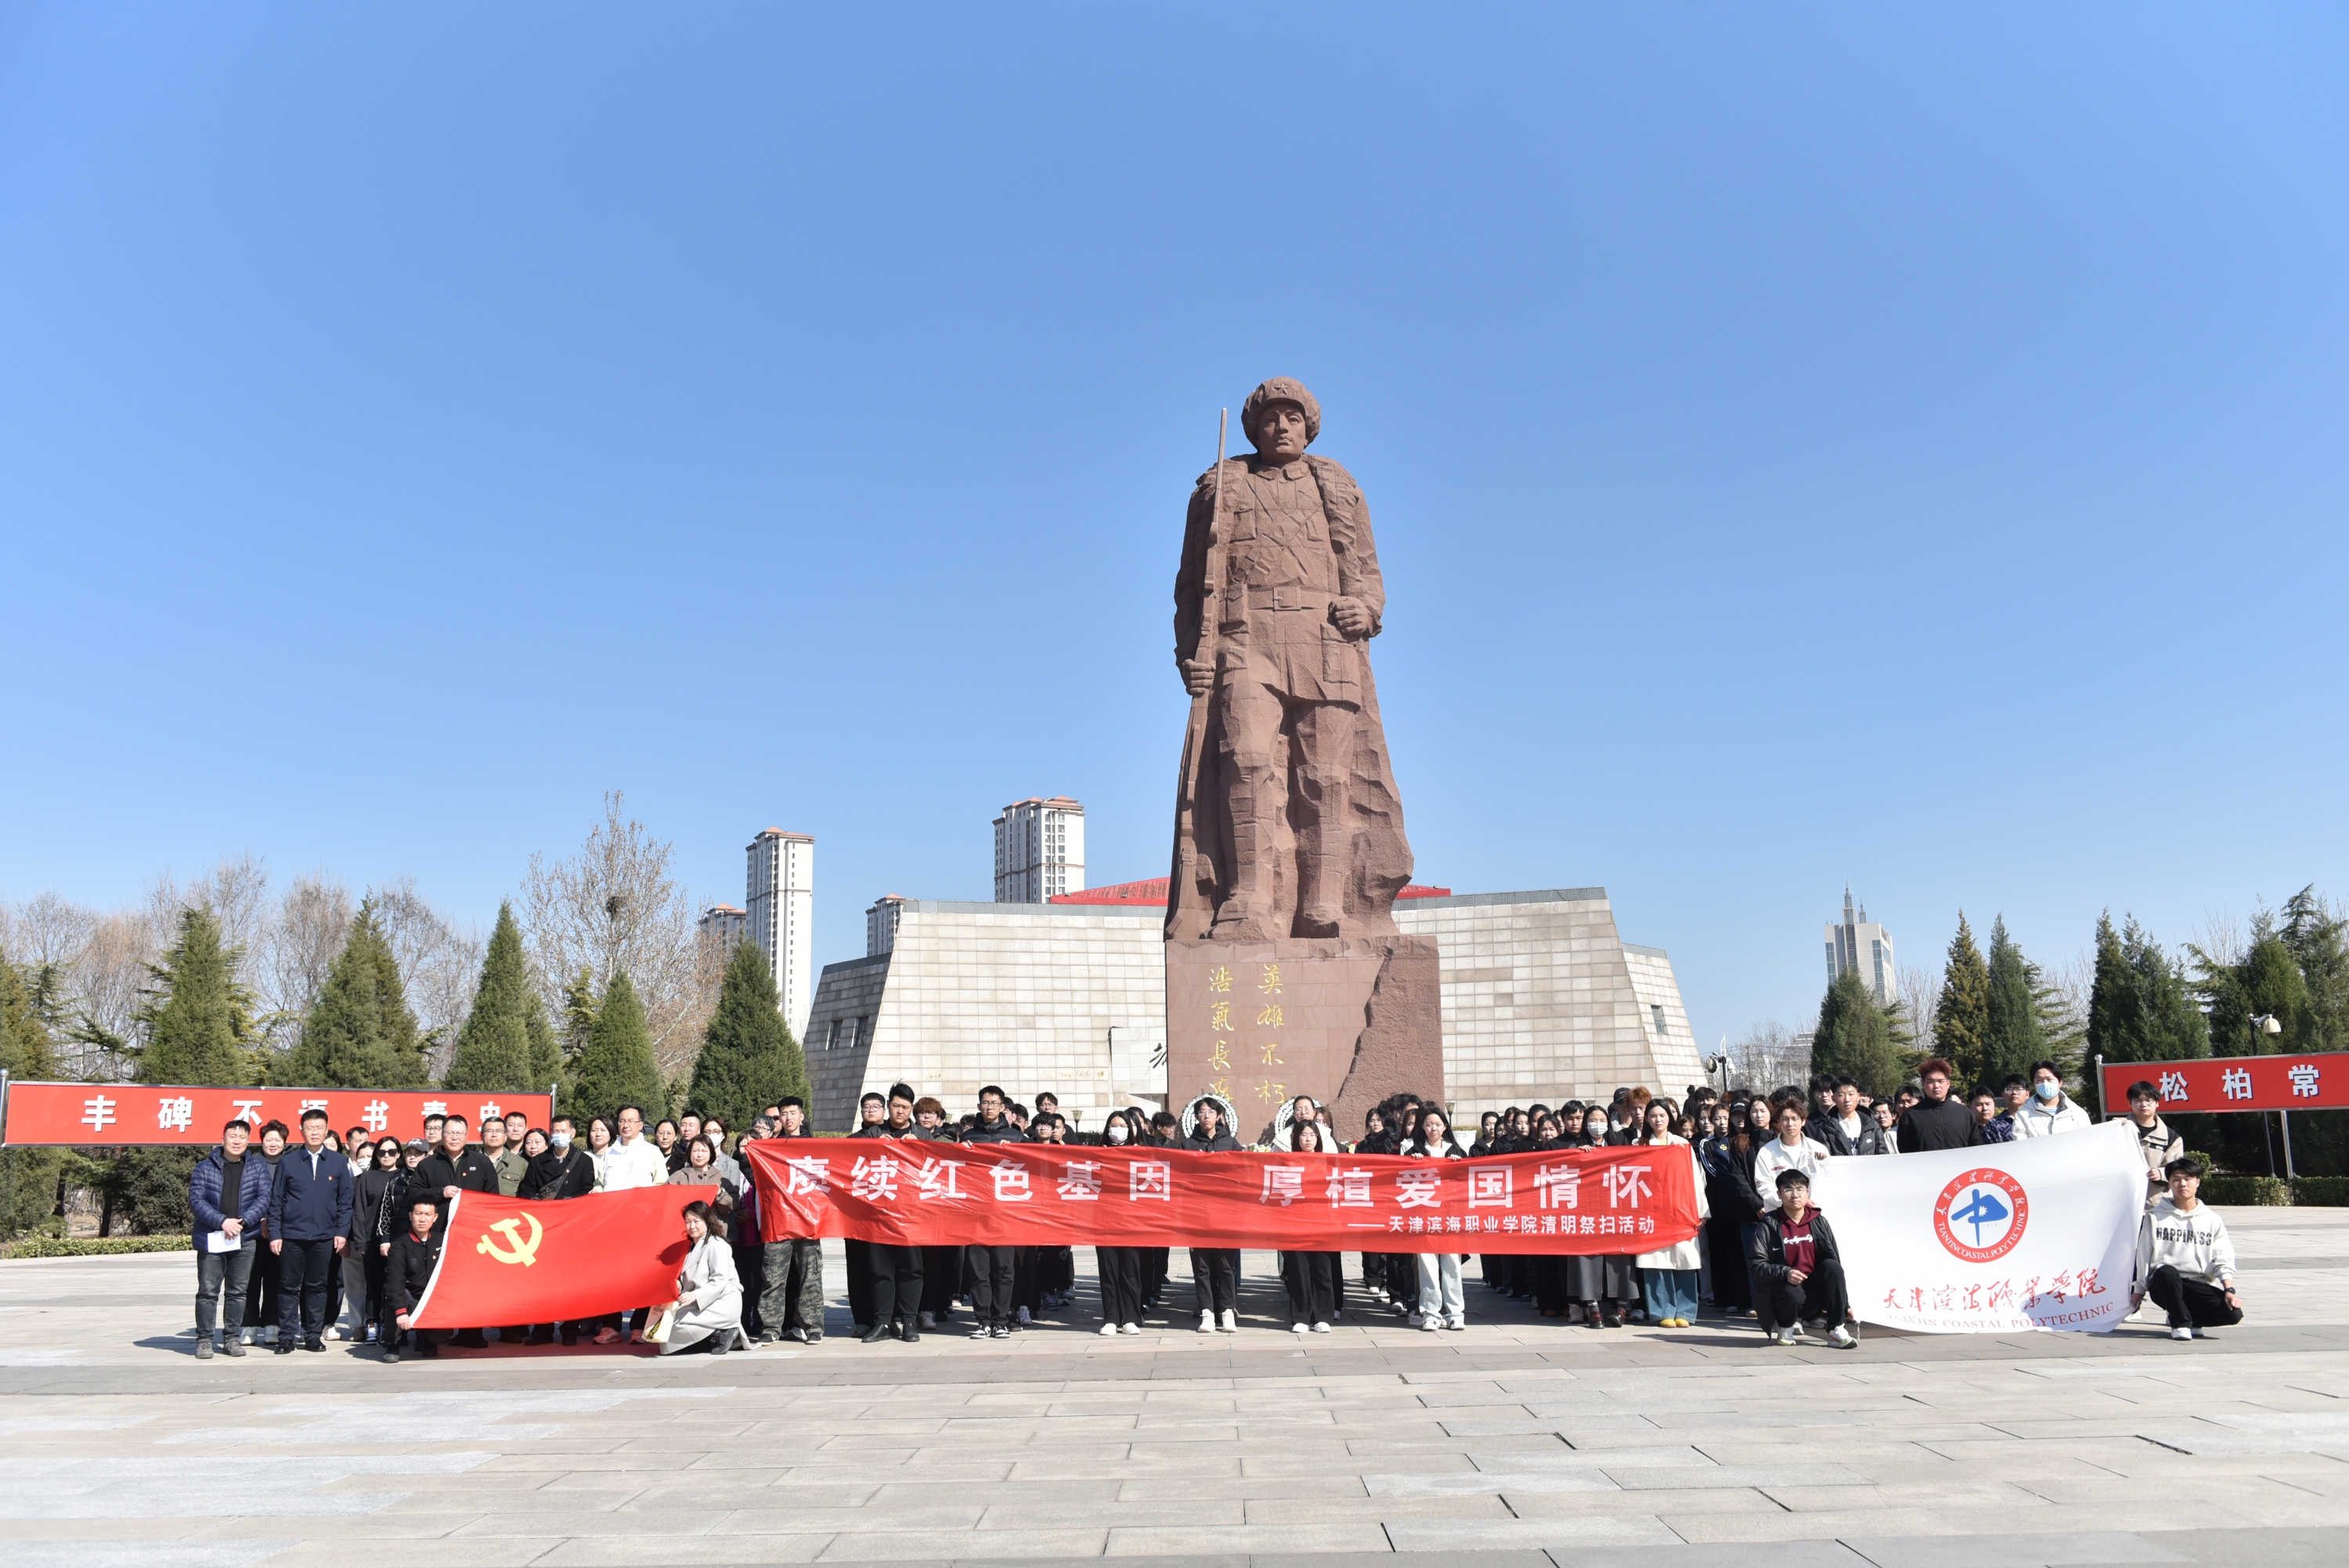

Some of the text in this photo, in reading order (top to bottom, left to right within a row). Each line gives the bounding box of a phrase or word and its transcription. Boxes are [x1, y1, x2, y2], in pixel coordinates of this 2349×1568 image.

[2159, 1064, 2320, 1102] 松柏常
[786, 1155, 1653, 1209] 赓续红色基因 厚植爱国情怀
[1943, 1319, 2006, 1328] COASTAL
[2012, 1302, 2114, 1328] POLYTECHNIC
